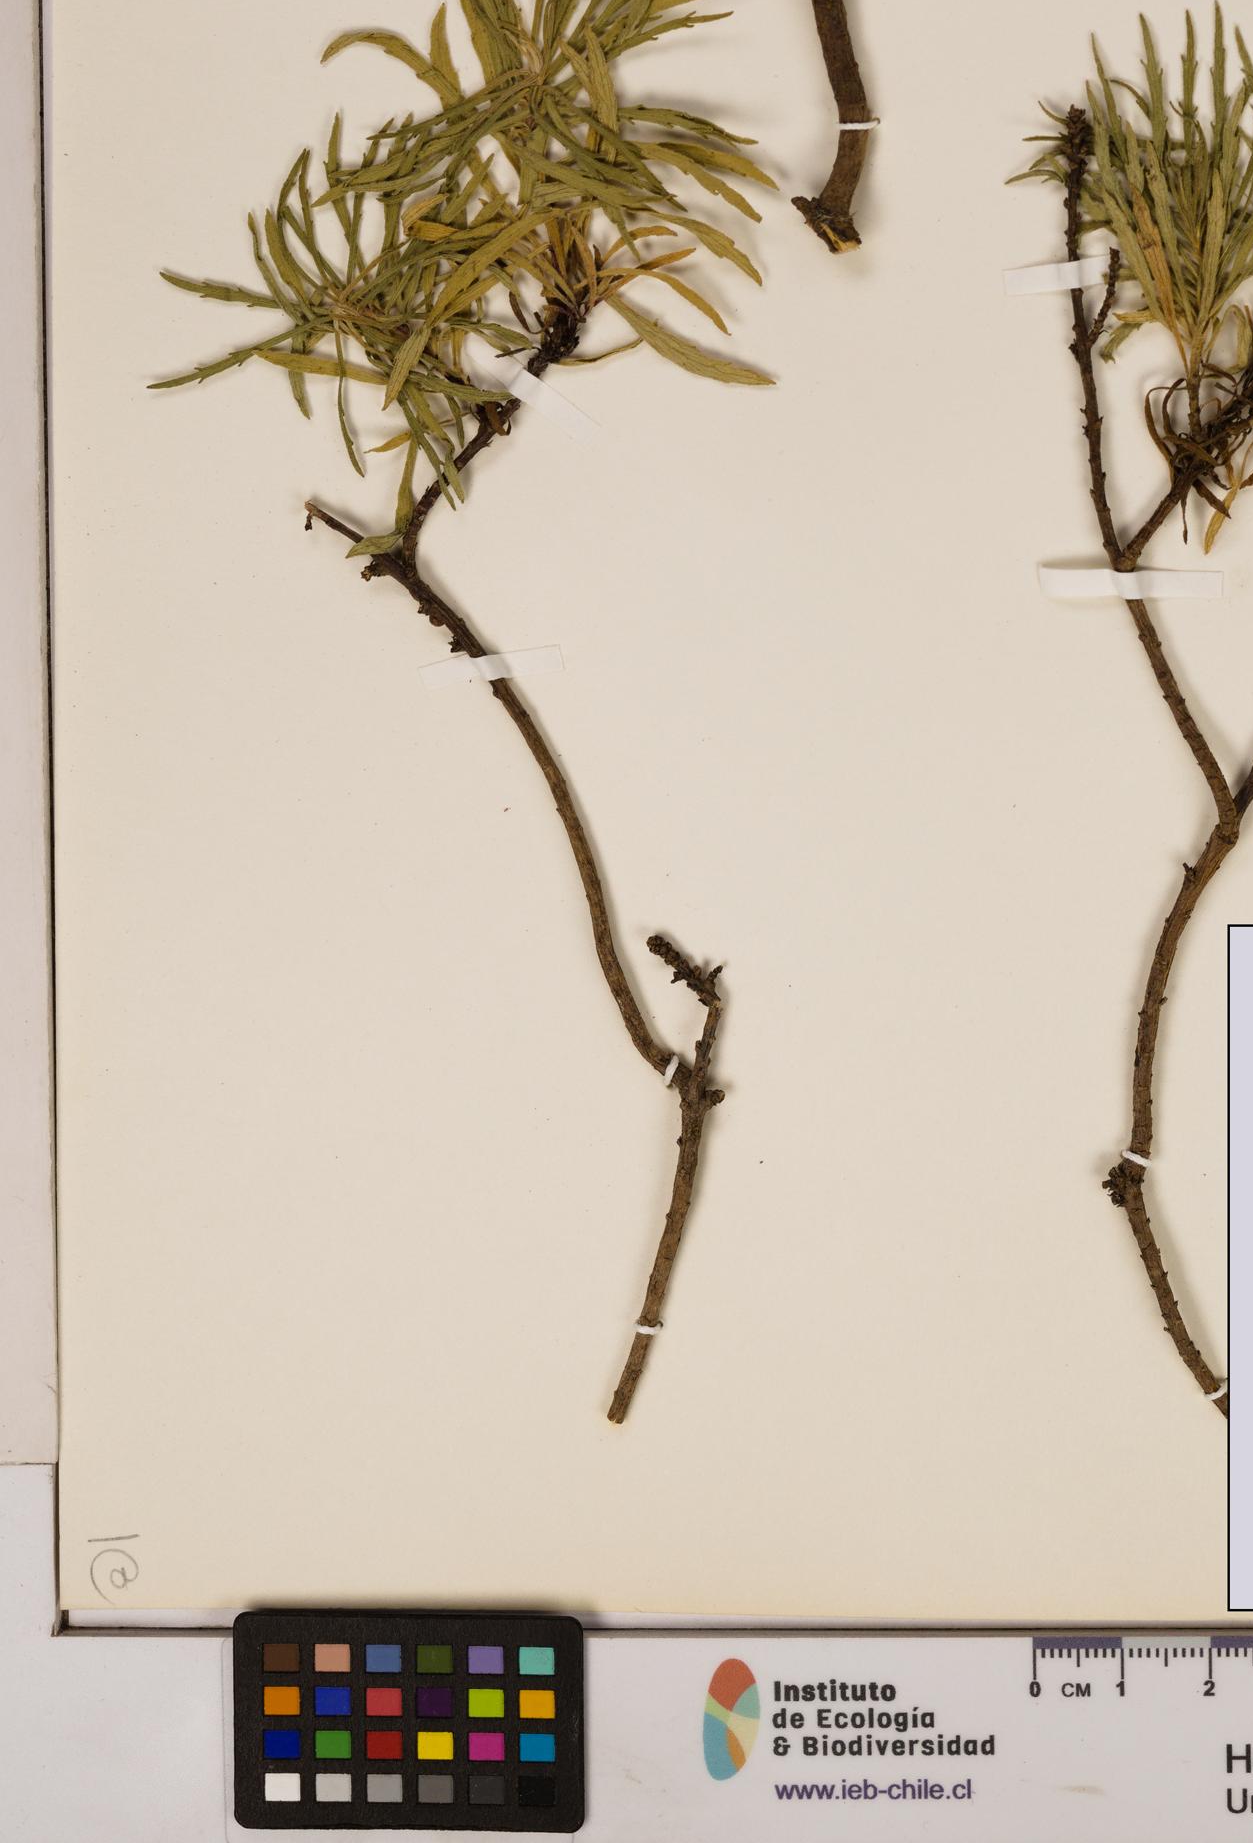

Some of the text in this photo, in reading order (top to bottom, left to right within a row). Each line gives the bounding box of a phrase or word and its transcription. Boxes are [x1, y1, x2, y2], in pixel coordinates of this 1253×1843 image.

[773, 1678, 897, 1702] Instituto
[1028, 1679, 1042, 1698] 0
[1061, 1682, 1092, 1698] CM
[1115, 1679, 1126, 1698] 1
[1202, 1678, 1216, 1697] 2
[772, 1706, 936, 1733] de Ecología
[772, 1733, 996, 1757] & Biodiversidad
[774, 1778, 973, 1801] www.ieb-chile.cl
